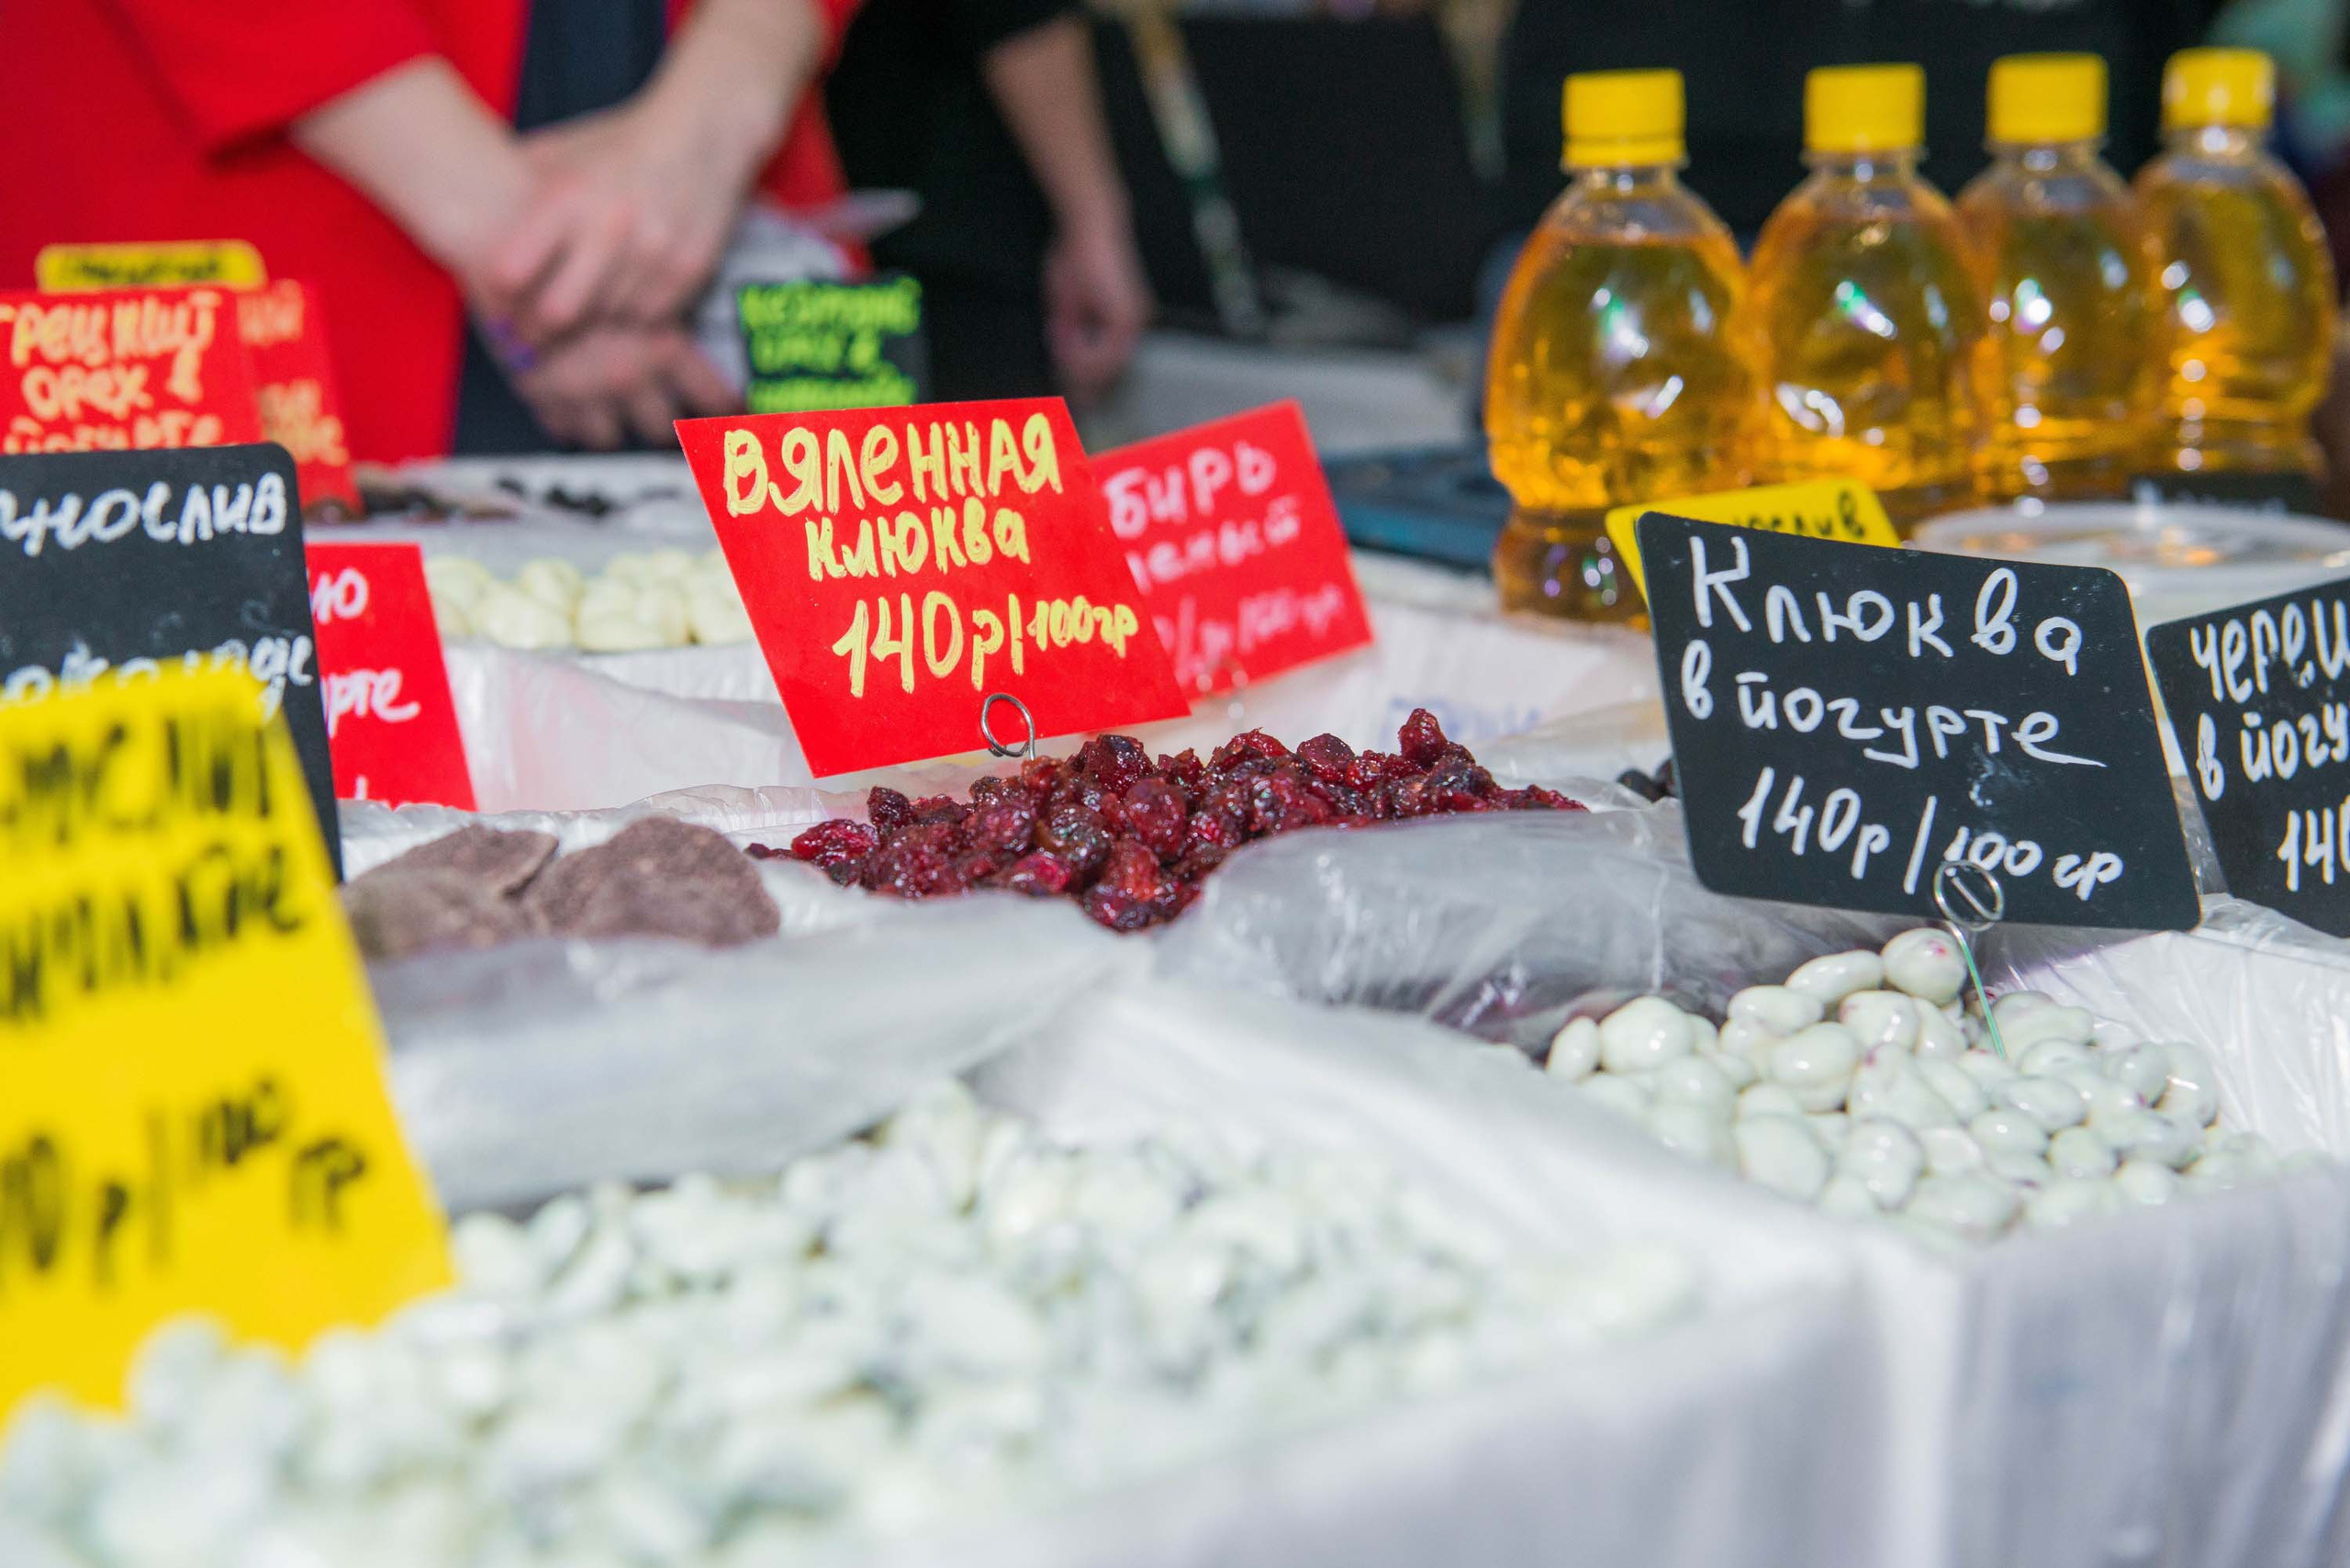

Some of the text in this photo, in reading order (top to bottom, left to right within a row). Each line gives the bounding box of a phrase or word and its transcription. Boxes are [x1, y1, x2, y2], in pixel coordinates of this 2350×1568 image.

[1690, 534, 2082, 676] Клюква
[1681, 640, 2108, 770] в йогурте
[2196, 712, 2225, 801] в
